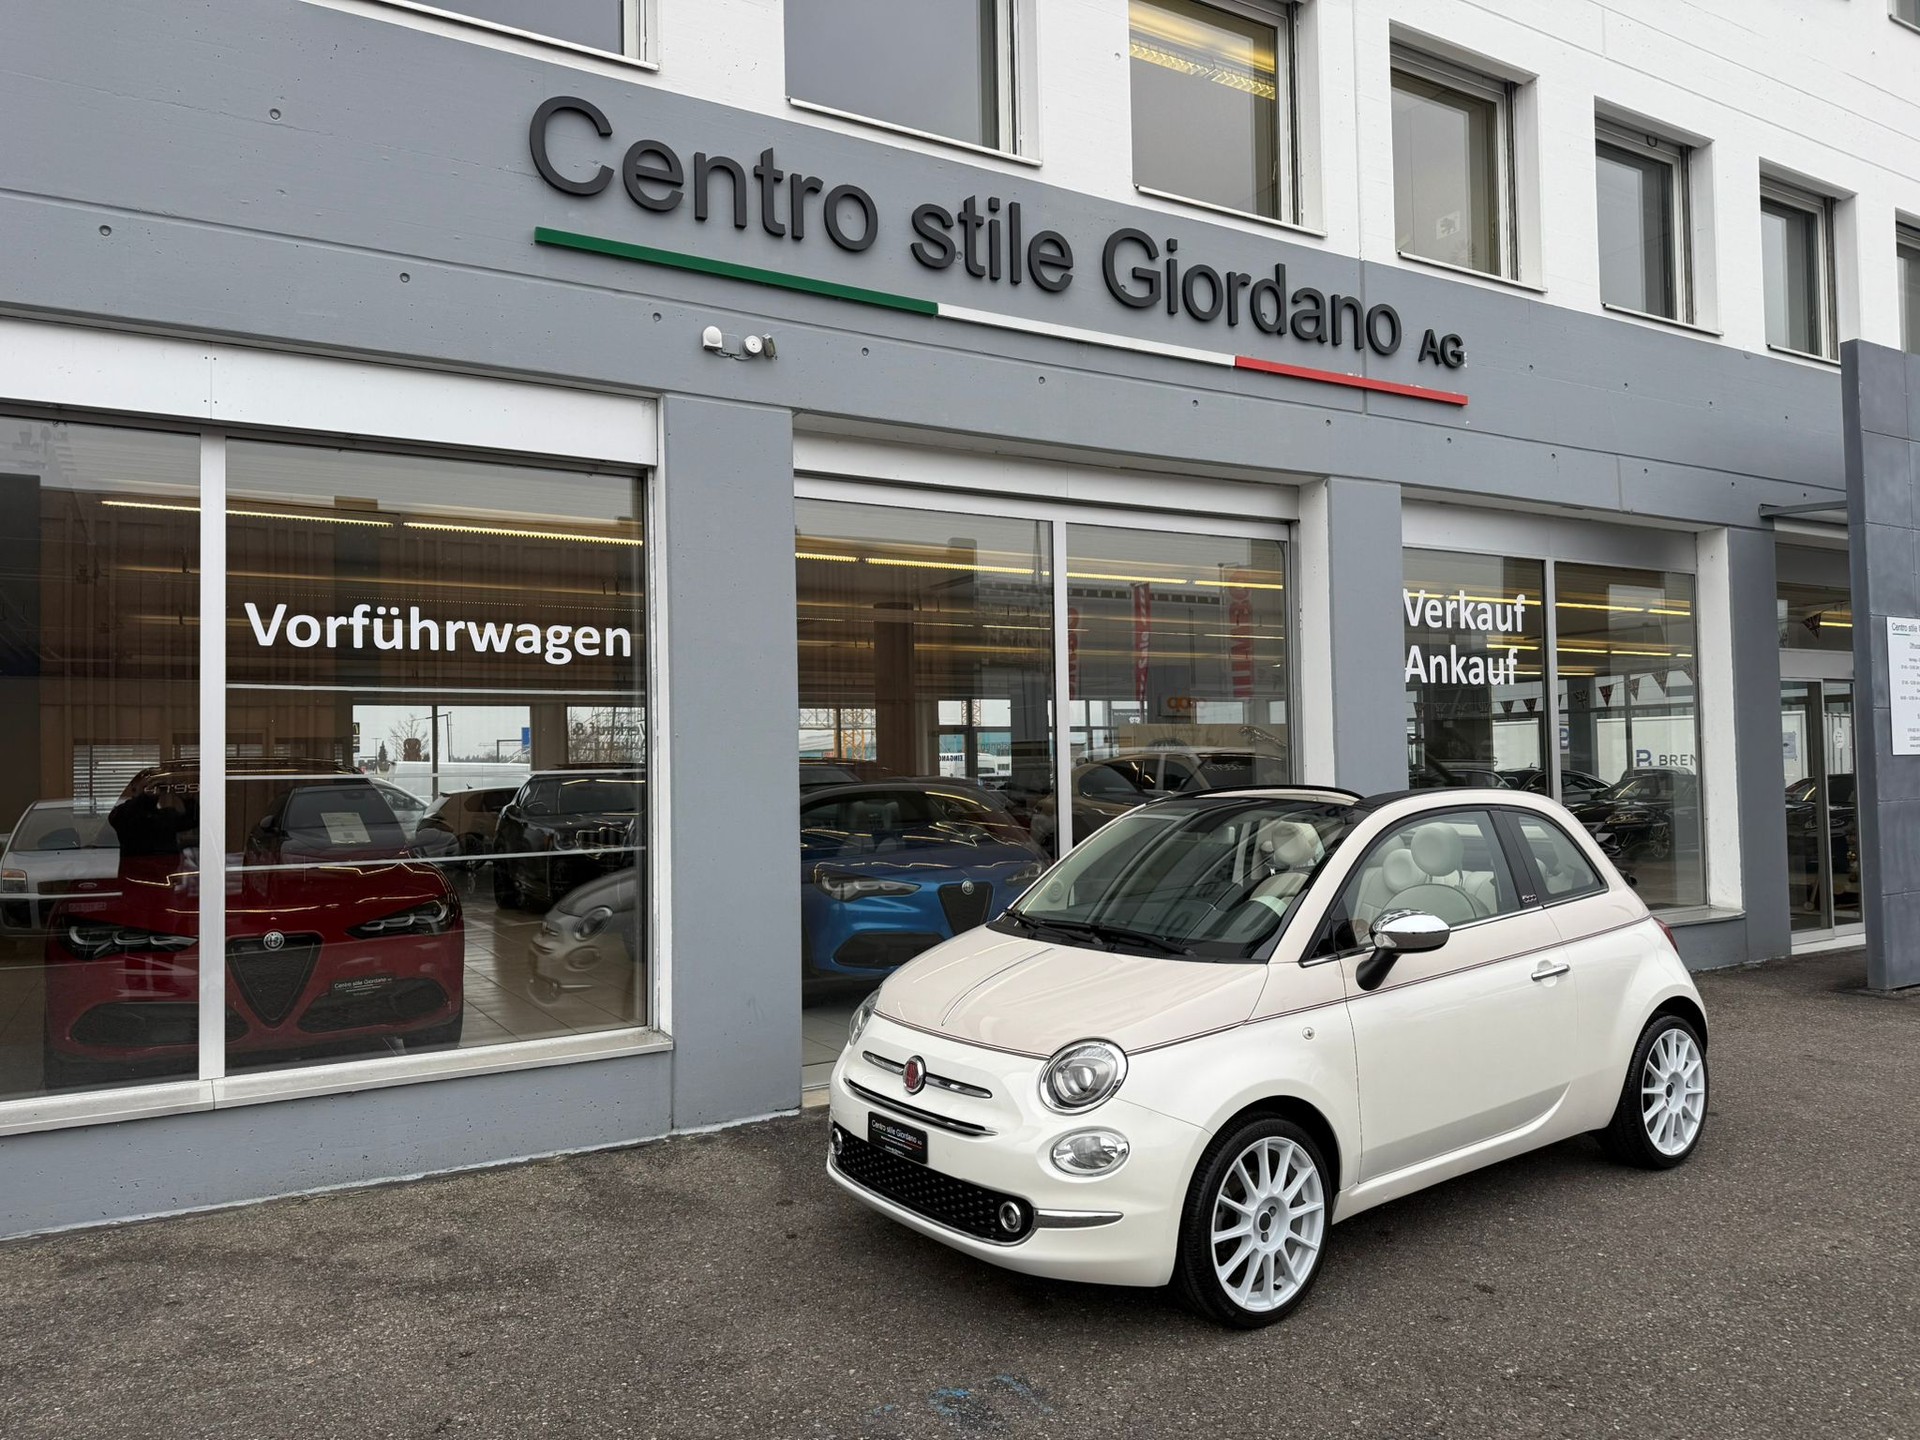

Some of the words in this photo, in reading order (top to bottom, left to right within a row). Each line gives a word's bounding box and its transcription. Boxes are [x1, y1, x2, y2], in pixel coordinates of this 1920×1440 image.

[529, 95, 879, 252] Centro
[910, 193, 1074, 293] stile
[1102, 227, 1402, 356] Giordano
[1418, 328, 1466, 369] AG
[1402, 588, 1526, 632] Verkauf
[243, 602, 632, 665] Vorführwagen
[1405, 644, 1518, 685] Ankauf
[872, 1119, 886, 1131] Centro
[887, 1126, 896, 1135] stile
[896, 1128, 917, 1144] Giordano
